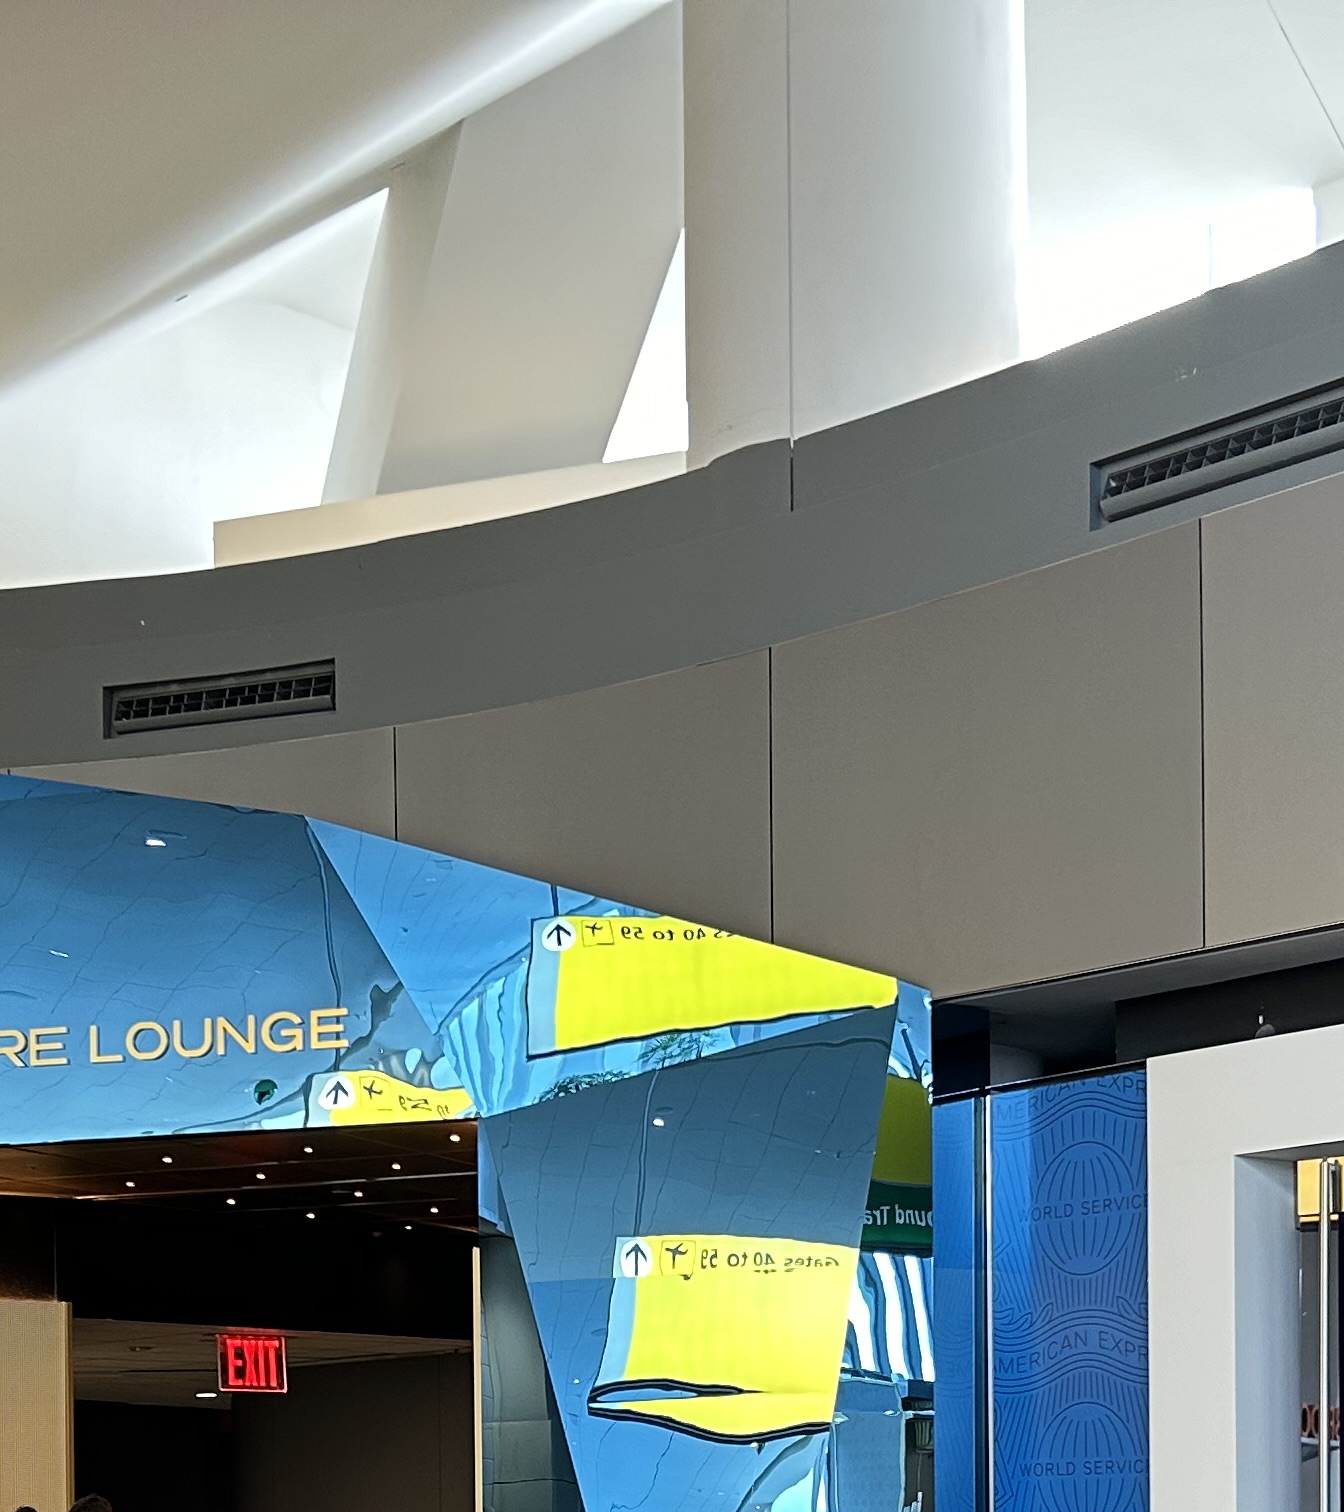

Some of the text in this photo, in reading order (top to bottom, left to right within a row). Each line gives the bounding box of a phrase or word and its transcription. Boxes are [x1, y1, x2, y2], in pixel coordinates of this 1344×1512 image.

[89, 1007, 350, 1064] LOUNGE
[1019, 1203, 1074, 1223] WORLD
[226, 1339, 279, 1387] EXIT
[1019, 1459, 1149, 1478] WORLD SERVIC
